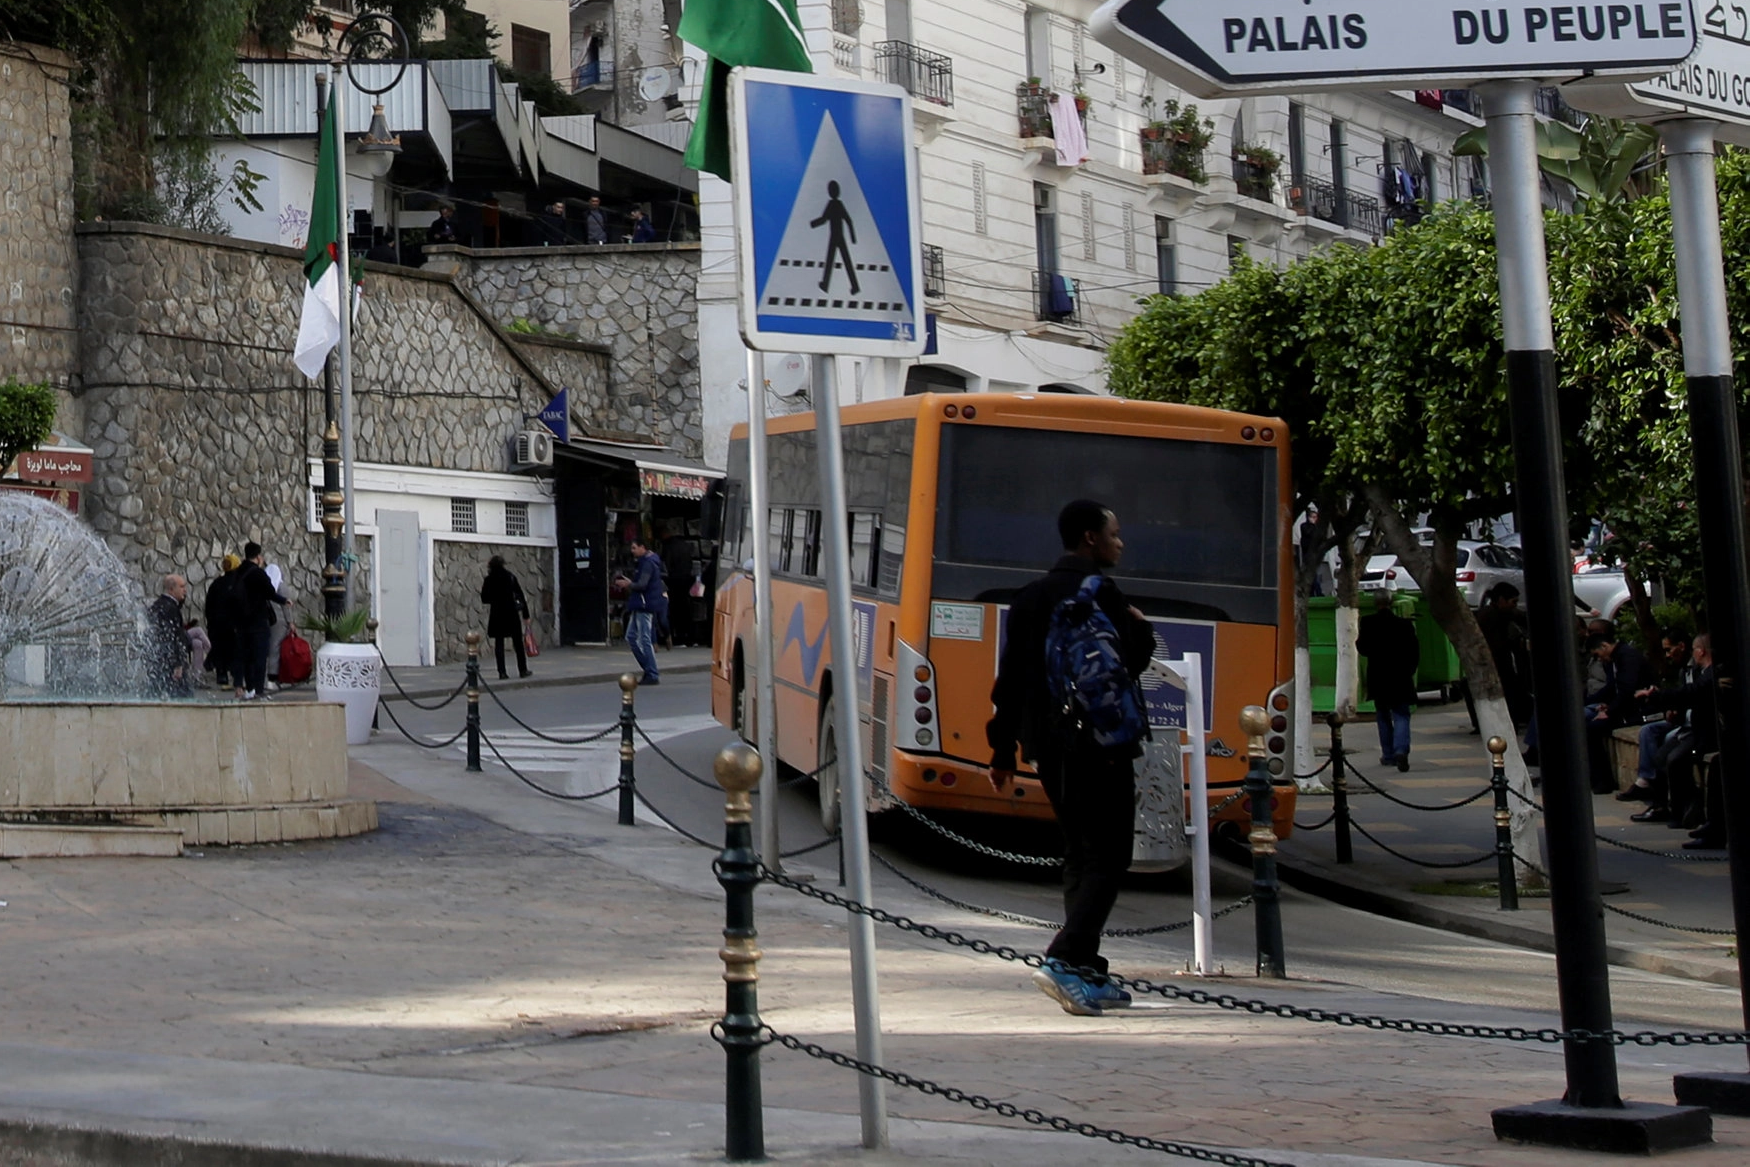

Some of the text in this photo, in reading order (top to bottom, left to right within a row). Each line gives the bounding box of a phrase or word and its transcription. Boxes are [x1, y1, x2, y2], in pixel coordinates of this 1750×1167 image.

[1223, 13, 1368, 53] PALAIS
[1452, 9, 1510, 45] DU
[1522, 2, 1686, 43] PEUPLE
[1650, 64, 1703, 96] ALAIS
[1707, 68, 1728, 102] DU
[43, 458, 57, 470] ماما
[58, 459, 82, 475] محاجب
[1162, 702, 1185, 712] Alger
